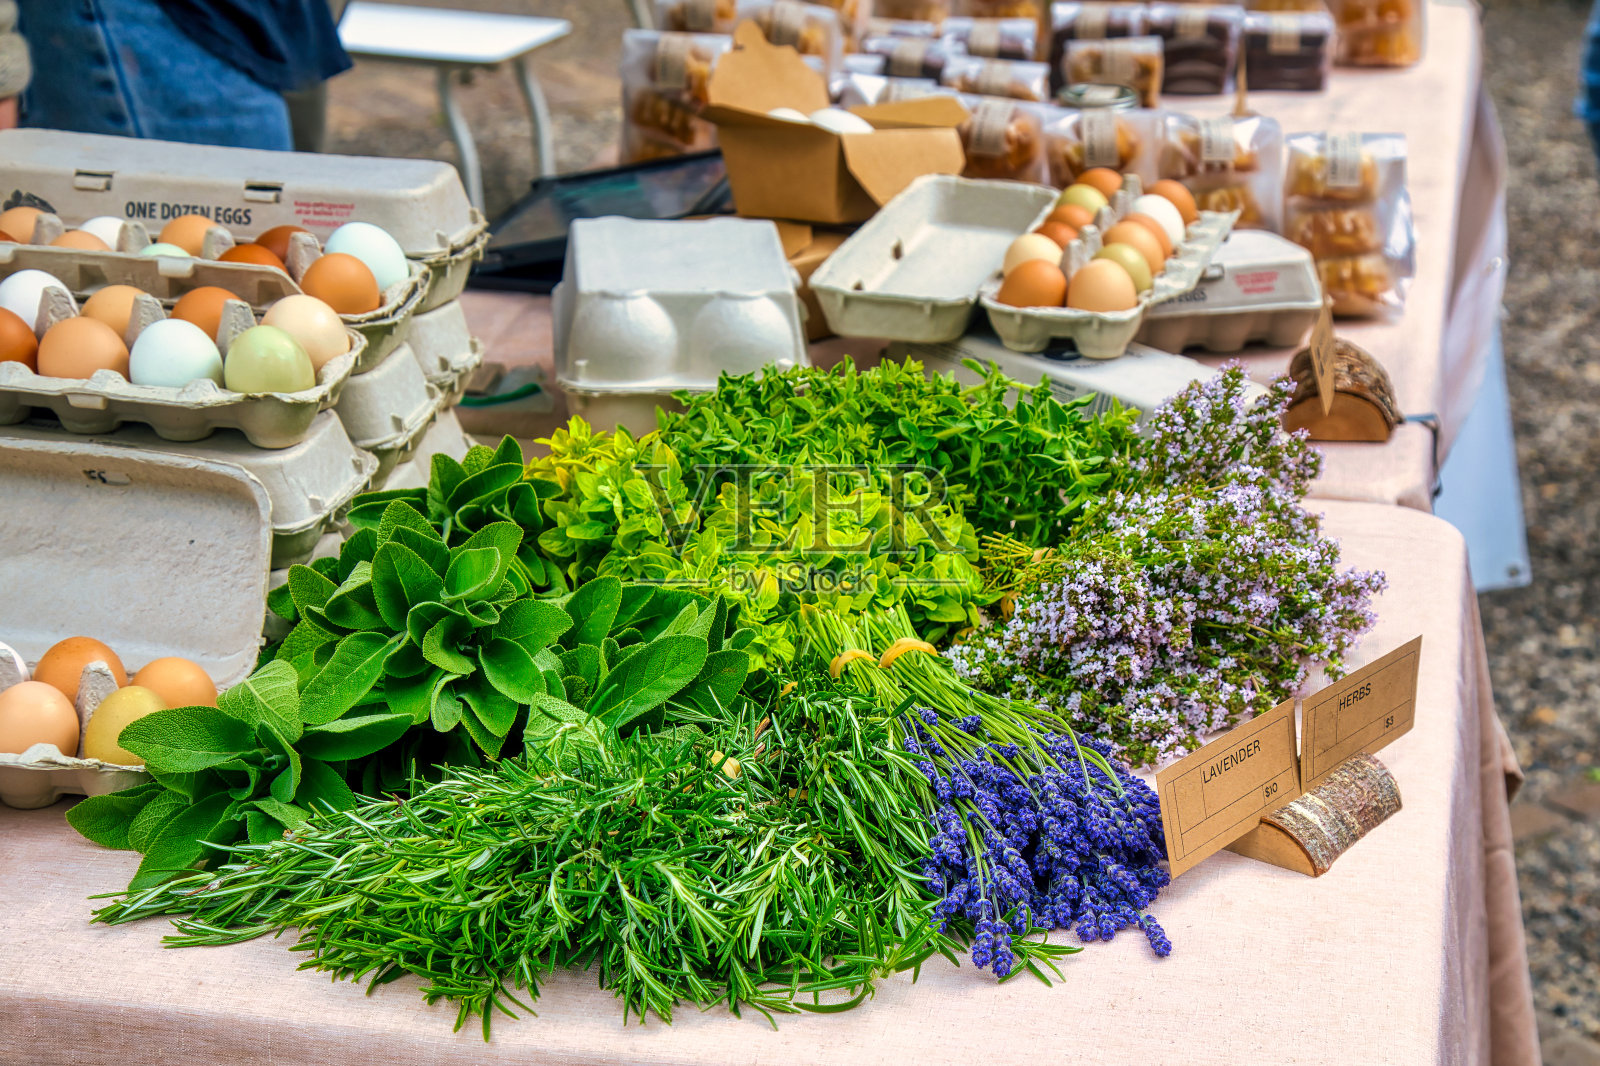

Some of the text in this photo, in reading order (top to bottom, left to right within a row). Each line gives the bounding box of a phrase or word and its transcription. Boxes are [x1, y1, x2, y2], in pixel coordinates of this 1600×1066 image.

[125, 201, 252, 225] ONE DOZEN EGGS
[1338, 682, 1372, 712] HERBS
[1385, 715, 1394, 728] $3
[1202, 739, 1261, 784] LAVENDER
[1264, 782, 1278, 798] $10
